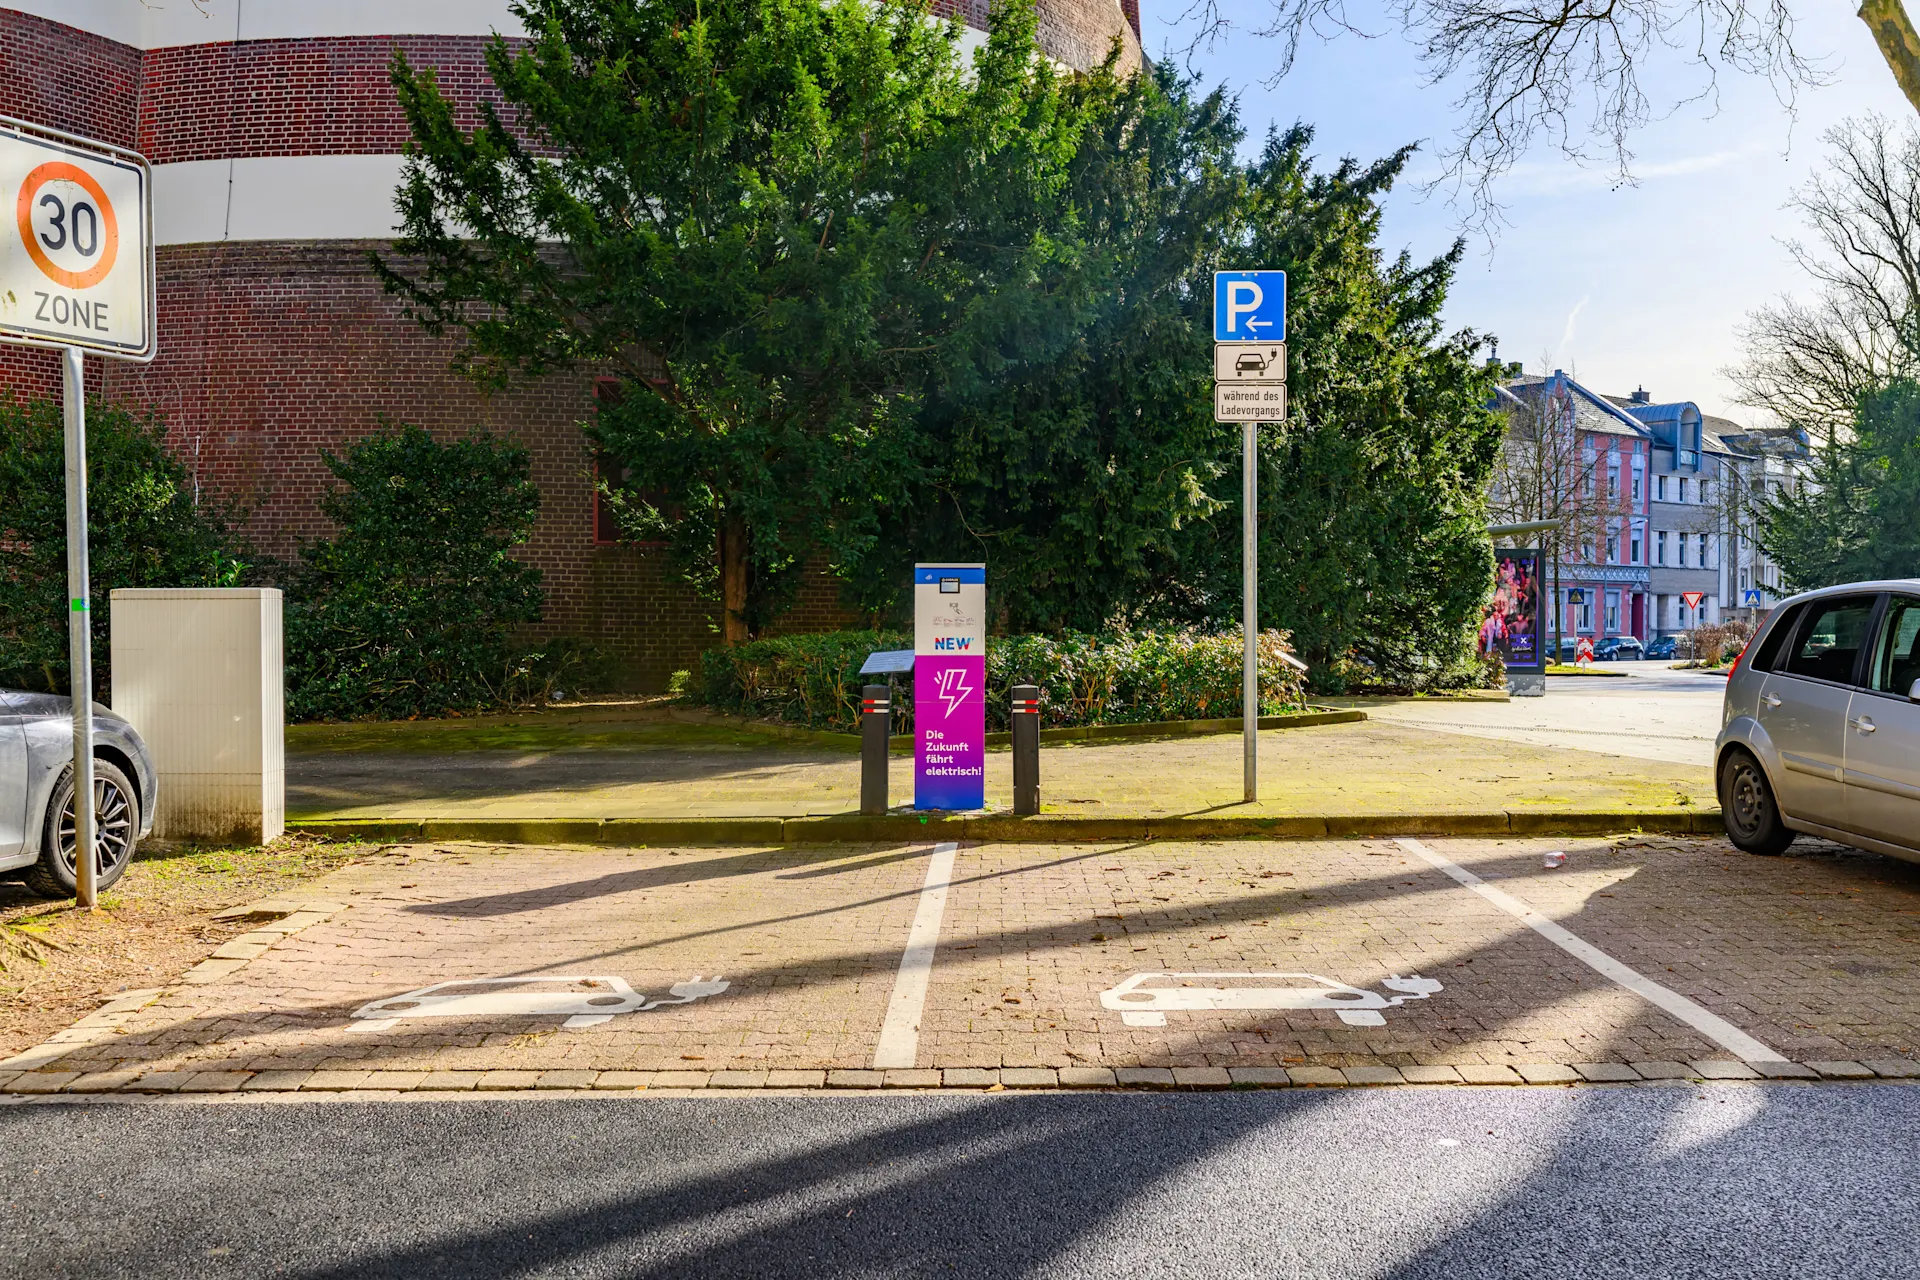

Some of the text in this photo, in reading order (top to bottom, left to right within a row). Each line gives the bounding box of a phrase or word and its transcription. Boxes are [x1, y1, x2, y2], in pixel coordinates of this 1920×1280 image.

[39, 193, 97, 257] 30
[34, 291, 109, 332] ZONE
[1227, 281, 1263, 332] P
[1223, 390, 1279, 401] während des
[1221, 404, 1280, 418] Ladevorgangs
[925, 729, 944, 740] Die
[925, 742, 969, 752] Zukunft
[925, 754, 954, 764] fährt
[925, 766, 982, 776] elektrisch!
